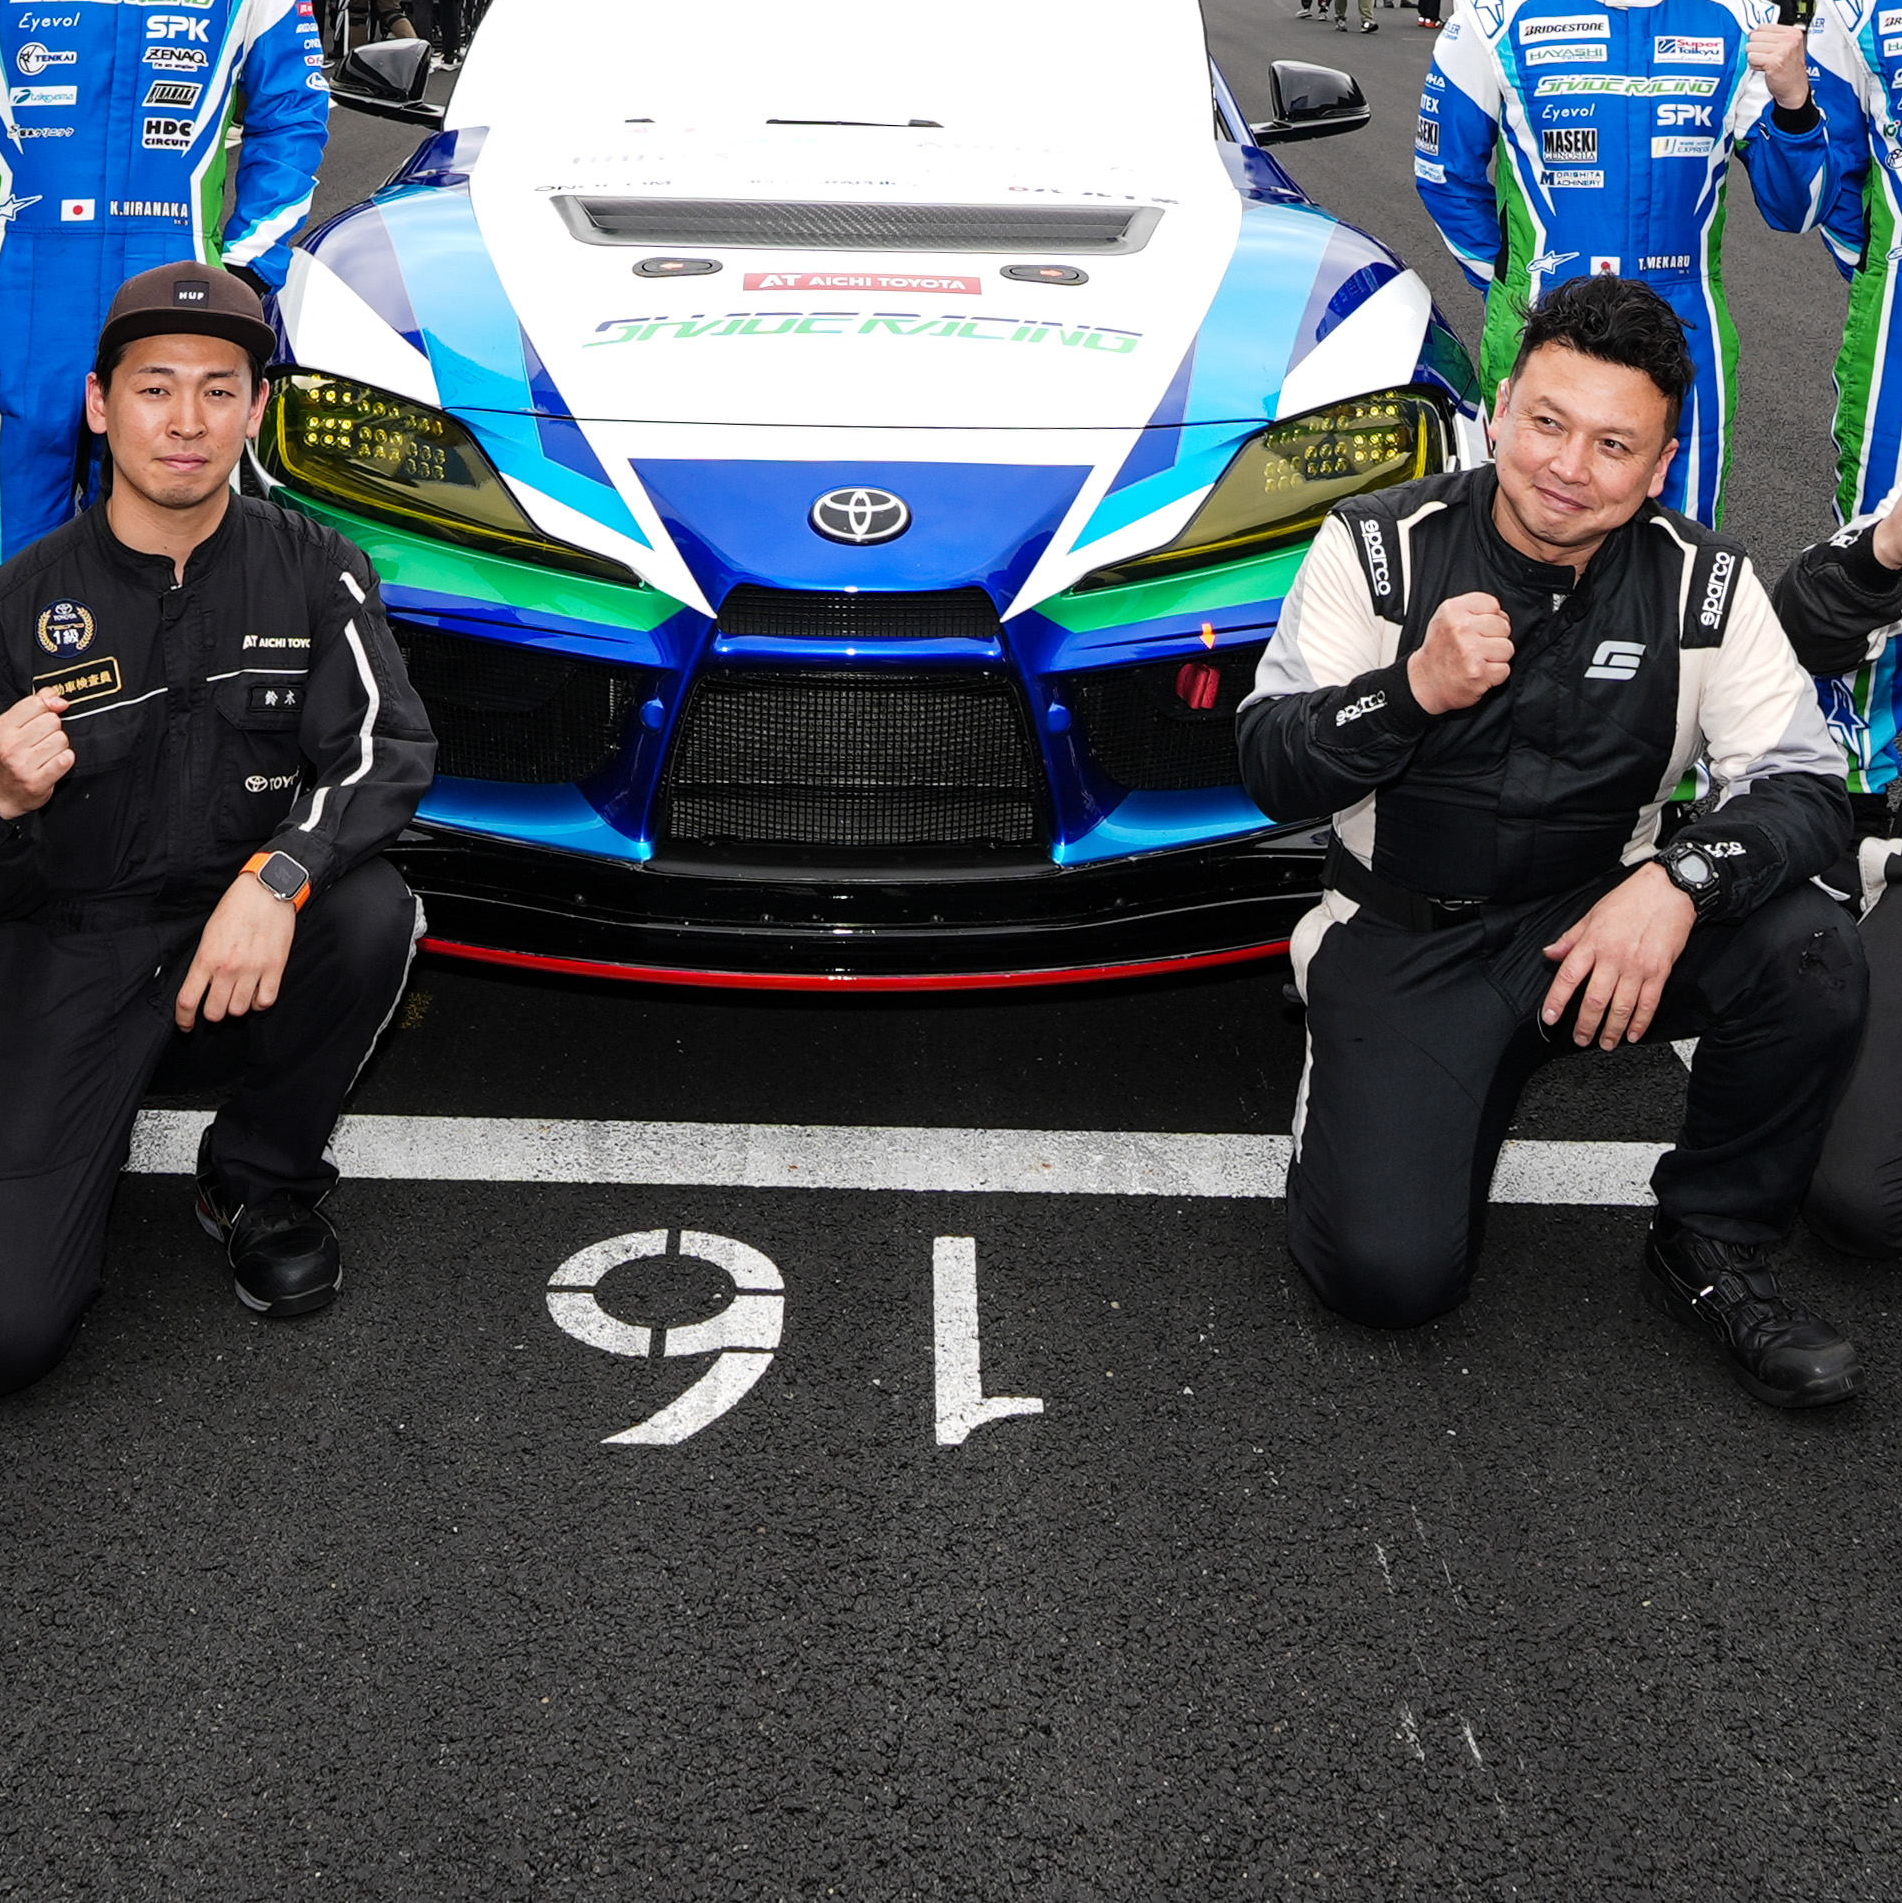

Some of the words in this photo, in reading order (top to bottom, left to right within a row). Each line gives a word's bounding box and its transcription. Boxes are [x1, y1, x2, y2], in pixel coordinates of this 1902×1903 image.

[18, 12, 81, 32] Eyevol
[146, 16, 208, 43] SPK
[1523, 22, 1605, 36] BRIDGESTONE
[1677, 38, 1721, 50] Super
[1677, 45, 1720, 56] Taikyu
[35, 54, 75, 64] TENKAI
[147, 48, 207, 65] ZENAQ
[1529, 48, 1603, 61] HAYASHI
[1537, 78, 1623, 95] SHADE
[1625, 79, 1717, 96] RACING
[1542, 103, 1596, 120] Eyevol
[1657, 104, 1713, 127] SPK
[146, 120, 192, 137] HDC
[145, 138, 190, 148] CIRCUIT
[1544, 129, 1596, 152] MASEKI
[110, 200, 188, 217] K.HIRANAKA
[1638, 254, 1690, 271] T.MEKARU
[759, 274, 801, 288] AT
[810, 275, 870, 287] AICHI
[878, 276, 966, 290] TOYOTA
[582, 311, 847, 348] SHADE
[858, 312, 1143, 353] RACING
[1359, 518, 1391, 597] sparco
[1700, 551, 1736, 630] sparco
[53, 629, 79, 645] 1級
[242, 635, 258, 650] AT
[259, 638, 286, 648] AICHI
[50, 670, 113, 696] 動車検査員
